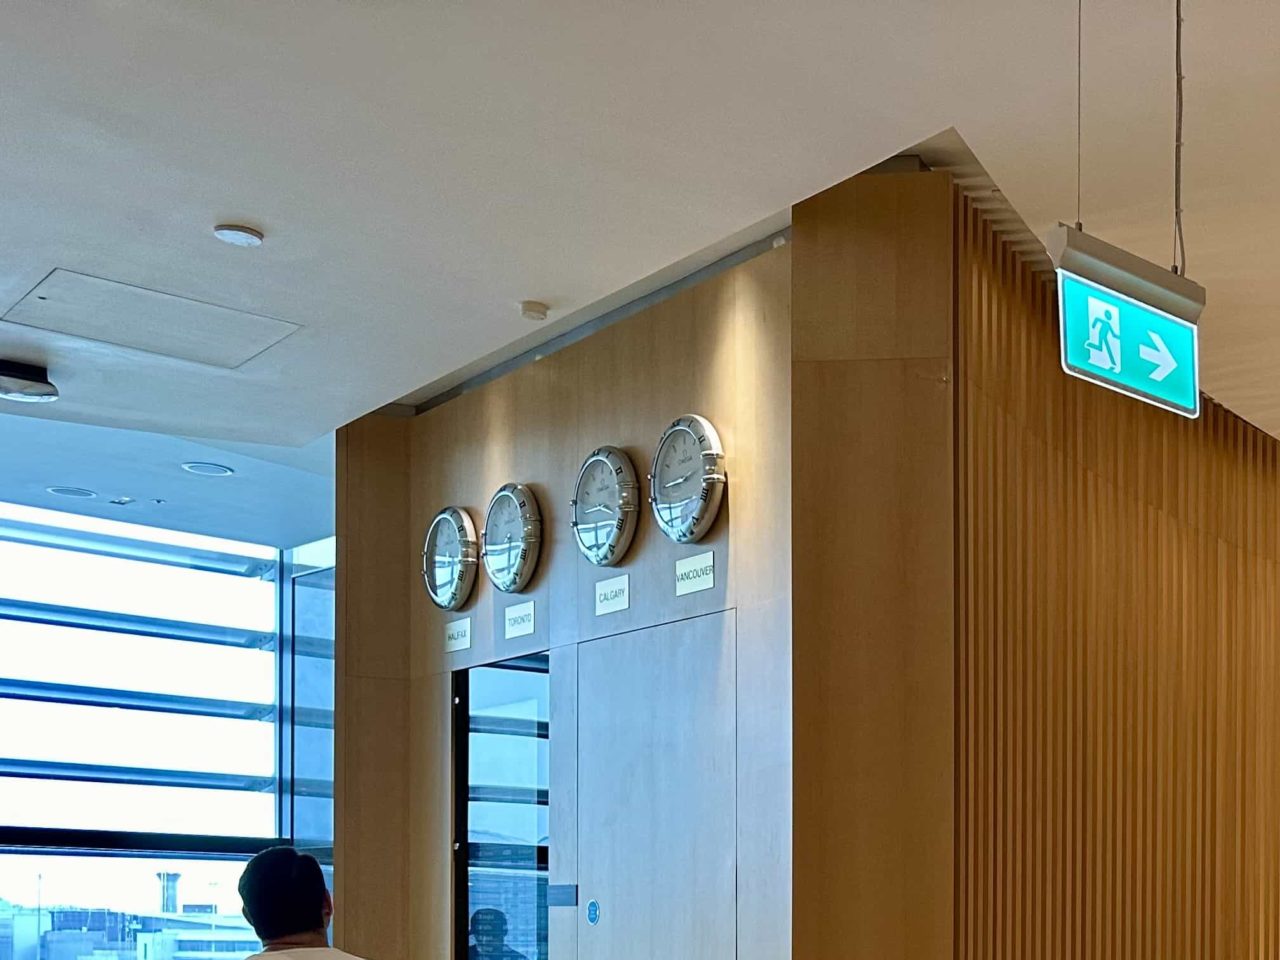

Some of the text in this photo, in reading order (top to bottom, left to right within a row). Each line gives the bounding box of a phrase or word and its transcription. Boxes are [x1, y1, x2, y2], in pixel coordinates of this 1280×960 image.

[676, 565, 713, 583] VANCOUVER
[598, 587, 625, 603] CALGARY
[508, 613, 531, 627] TORONTO
